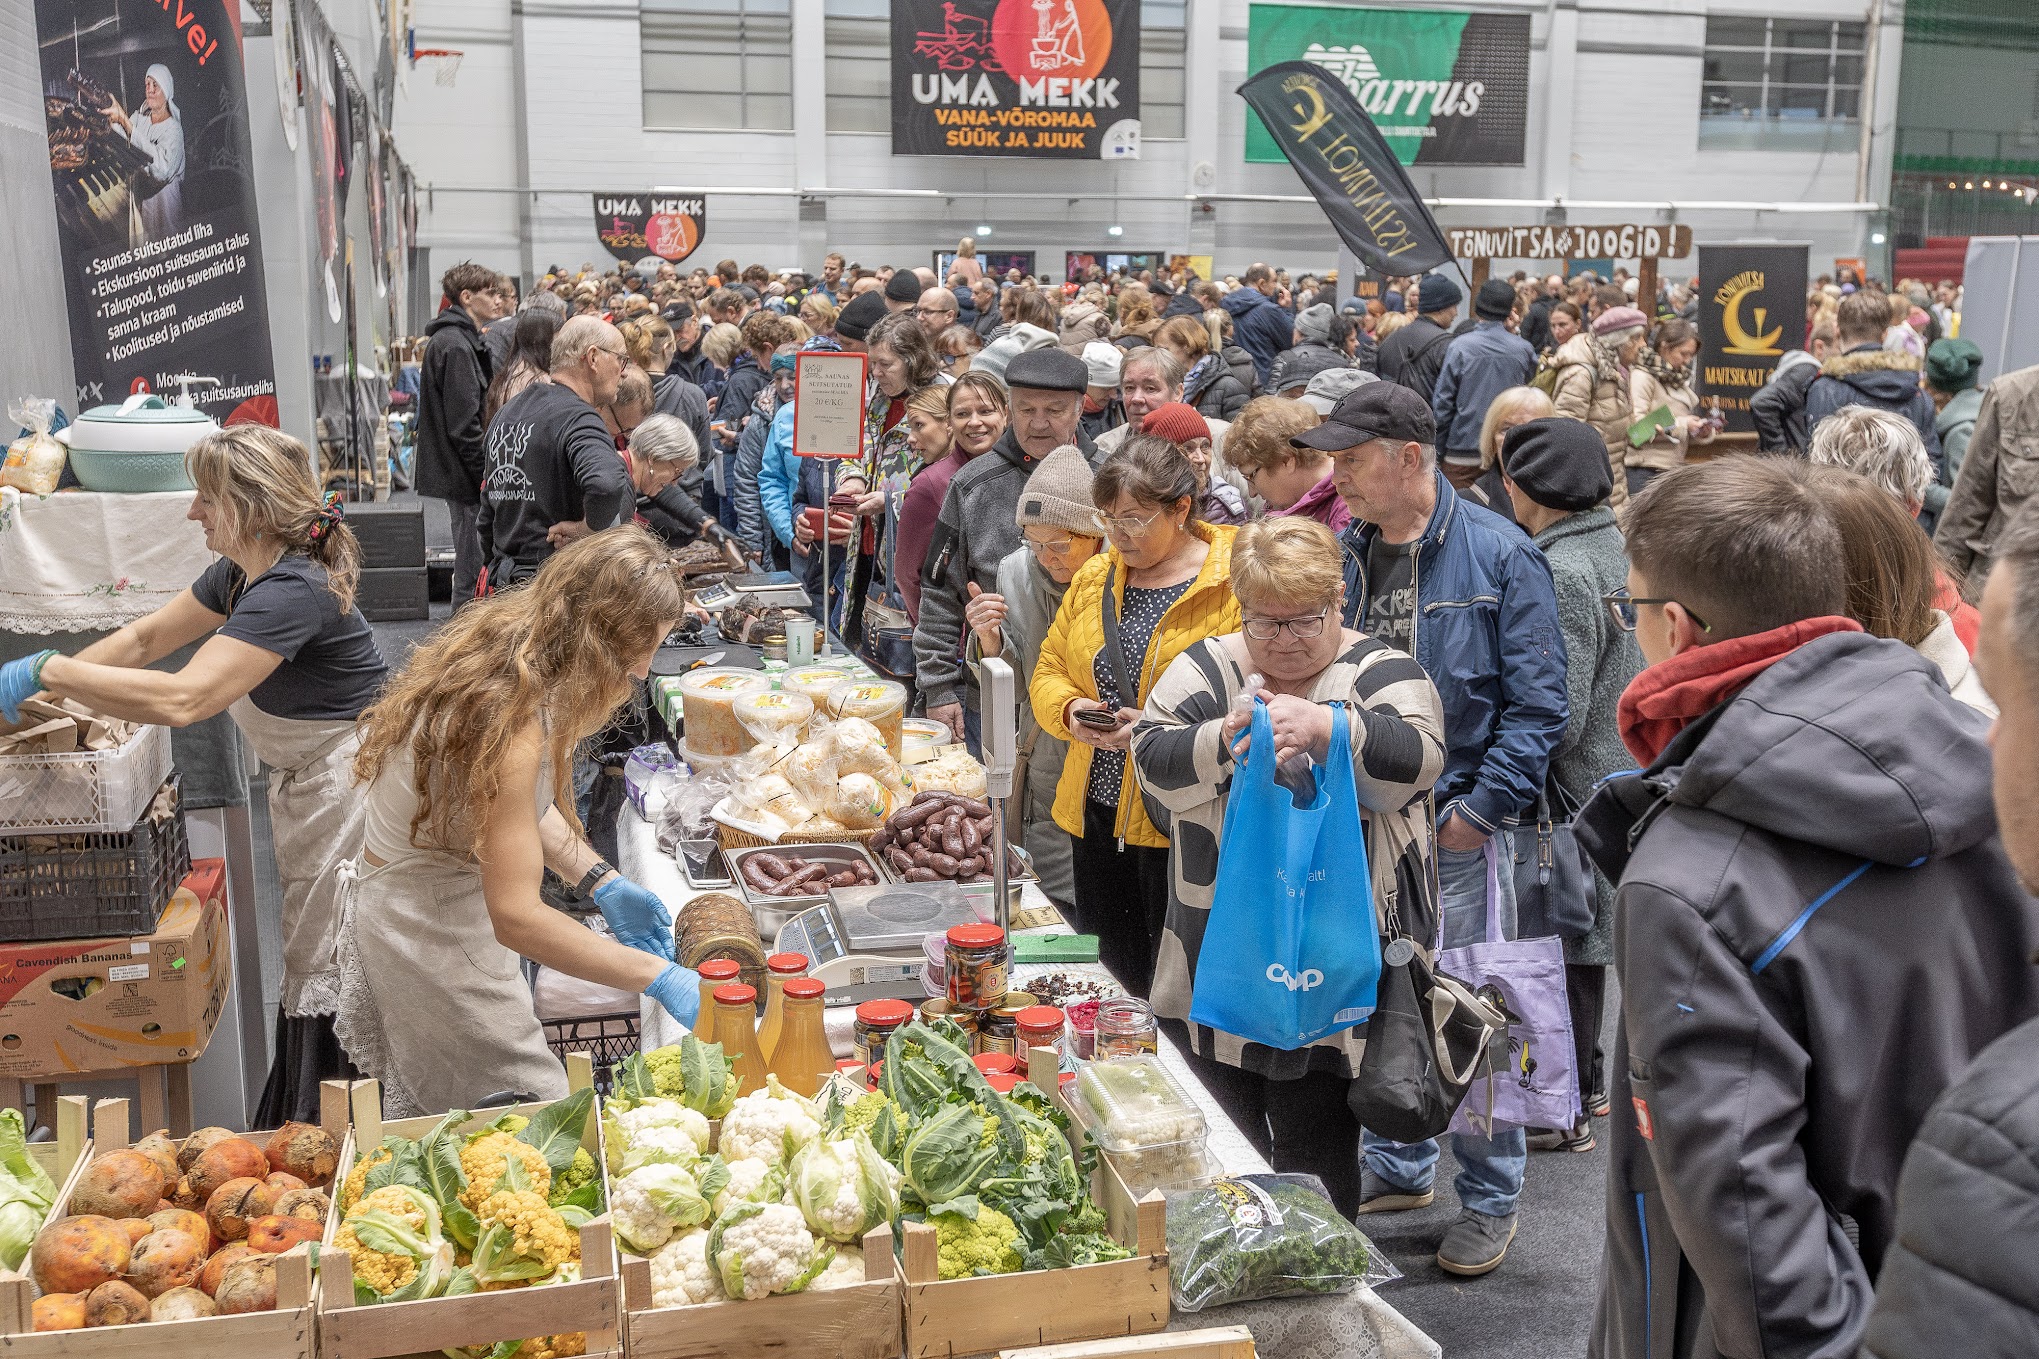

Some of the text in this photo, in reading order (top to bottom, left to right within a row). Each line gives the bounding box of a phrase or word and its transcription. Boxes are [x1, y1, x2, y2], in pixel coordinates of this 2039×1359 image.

[911, 72, 1121, 109] UMA MEKK
[934, 107, 1097, 128] VANA-VÕROMAA
[1004, 132, 1026, 148] JA
[1032, 133, 1085, 149] JUUK
[597, 198, 703, 216] UMA MEKK
[92, 222, 213, 276] Saunas suitsutatud liha
[97, 232, 250, 297] Ekskursioon suitsusauna talus
[102, 255, 247, 319] Talupood, toidu suveniirid ja
[107, 303, 177, 341] sanna kraam
[112, 295, 245, 362] Koolitused ja nõustamised
[200, 380, 274, 404] suitsusaunaliha
[16, 951, 133, 968] Cavendish Bananas
[66, 1024, 118, 1052] goodness inside
